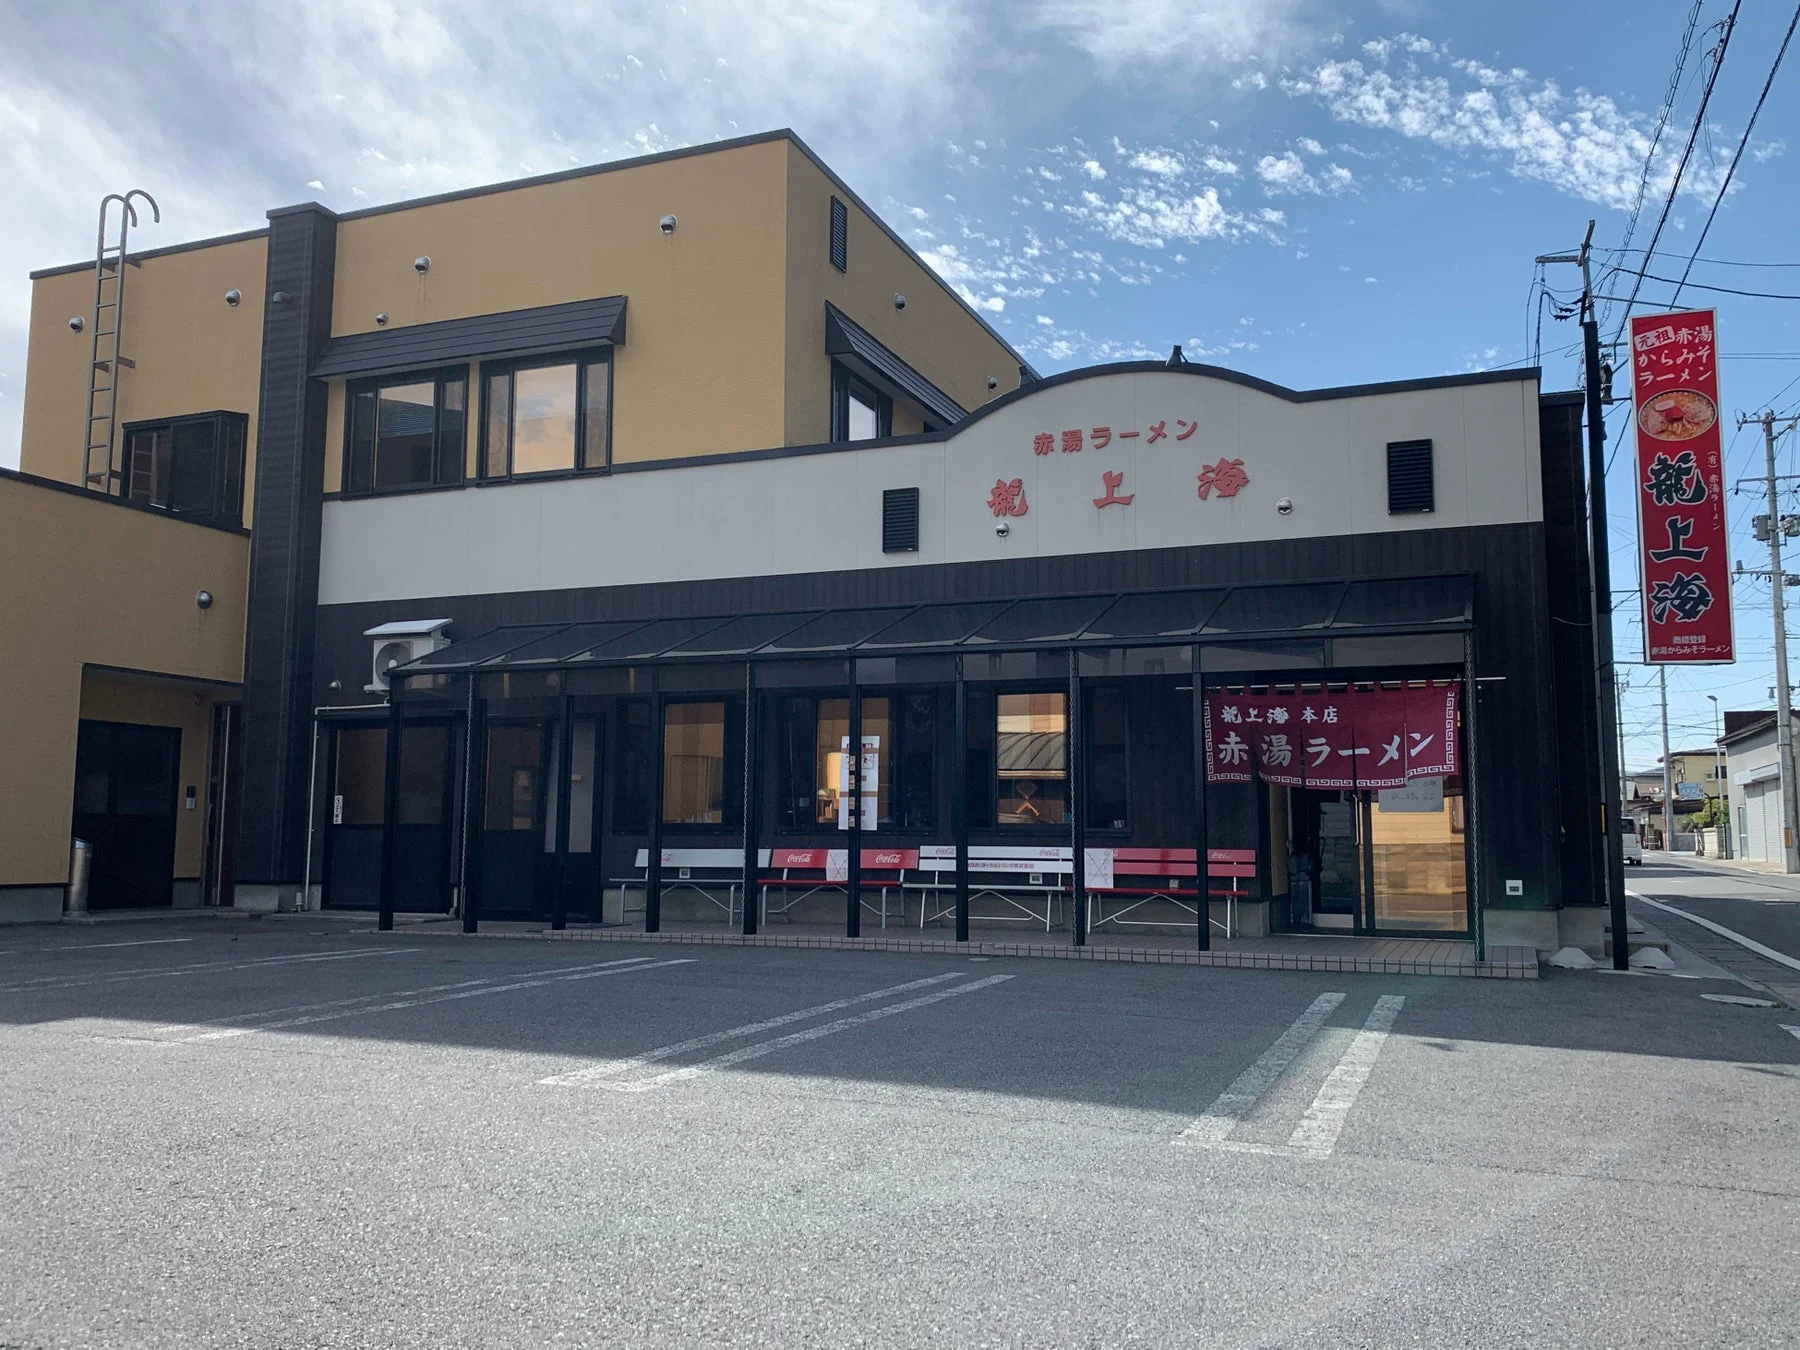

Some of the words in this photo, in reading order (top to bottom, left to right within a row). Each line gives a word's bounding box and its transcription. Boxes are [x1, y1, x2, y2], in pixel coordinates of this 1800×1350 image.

[1639, 329, 1672, 350] 元祖
[1675, 325, 1713, 345] 赤湯
[1637, 345, 1711, 368] からみそ
[1639, 366, 1712, 387] ラーメン
[1033, 420, 1198, 456] 赤湯ラーメン
[987, 457, 1250, 517] 龍上海
[1643, 451, 1715, 625] 龍上海
[1300, 706, 1339, 724] 本店
[1217, 731, 1434, 768] 赤湯ラーメン
[787, 853, 812, 863] Coca-Cola
[875, 853, 901, 864] Coca-Cola
